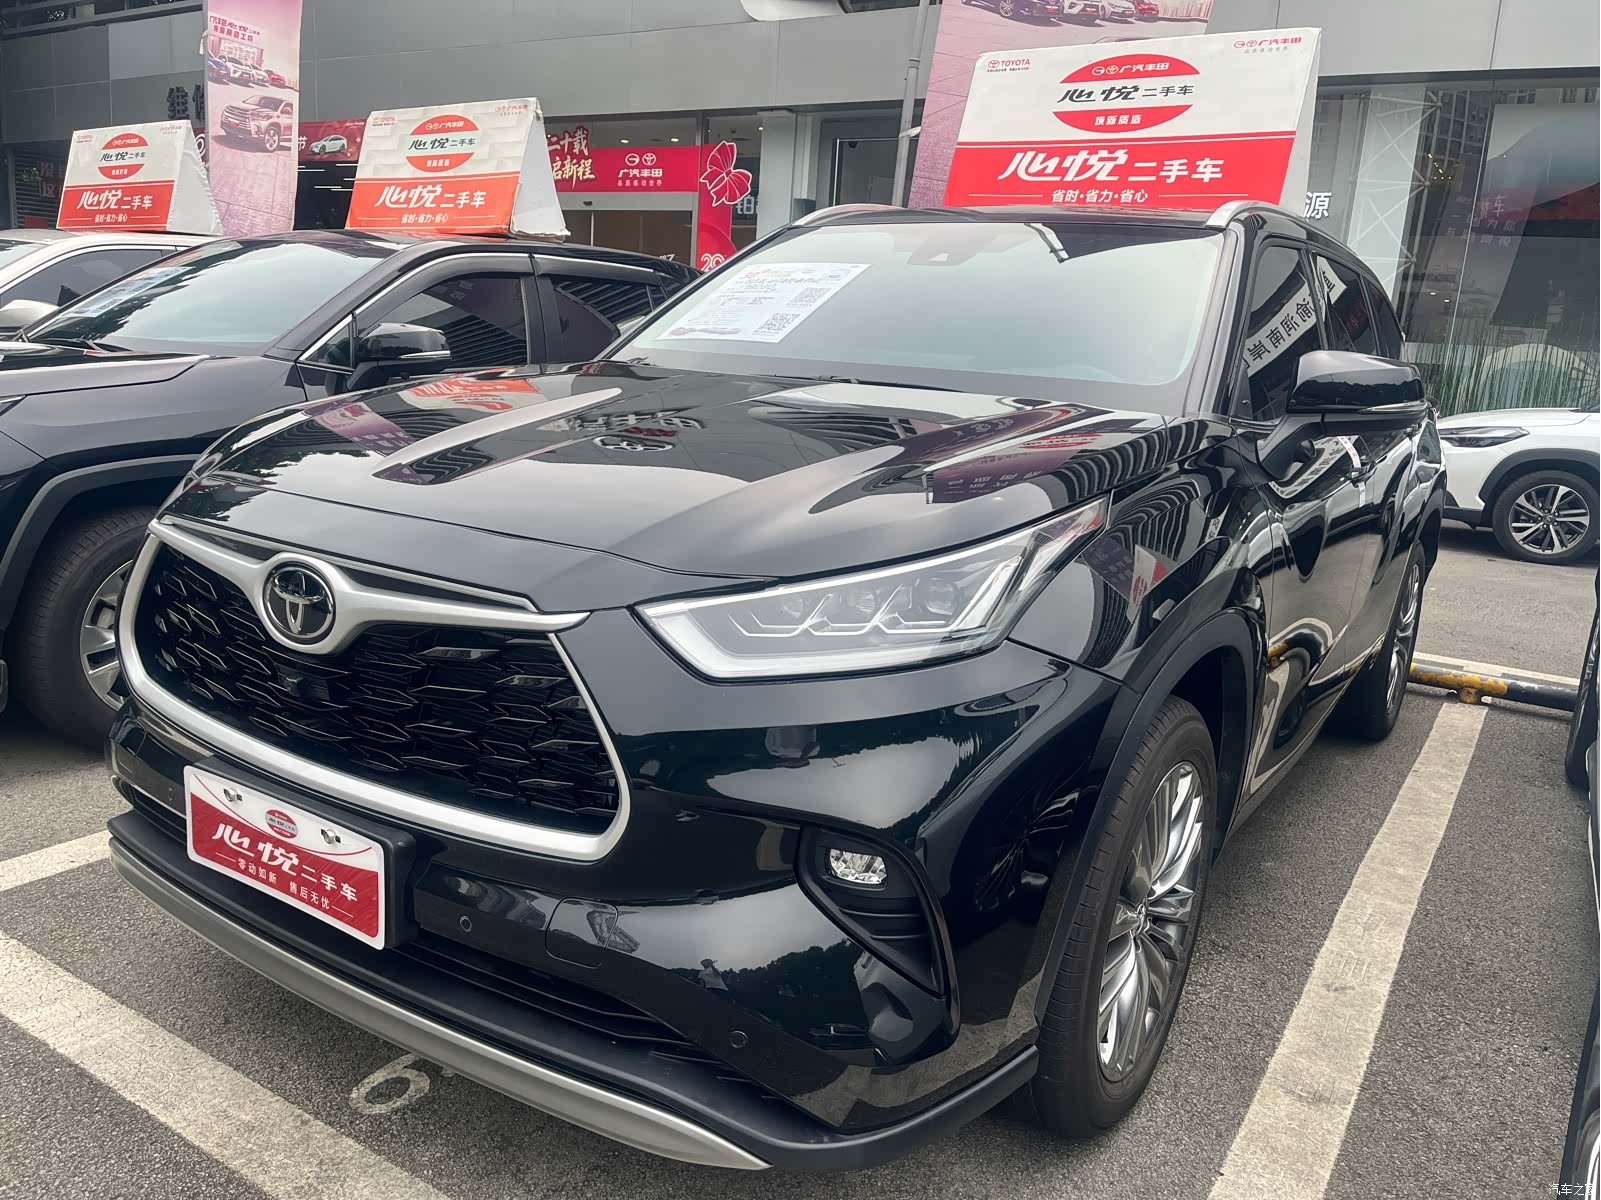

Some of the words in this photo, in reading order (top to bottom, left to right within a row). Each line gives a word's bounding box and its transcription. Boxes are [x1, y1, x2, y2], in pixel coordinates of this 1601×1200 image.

[1258, 37, 1302, 46] 广汽丰田
[1000, 58, 1030, 67] TOYOTA
[1119, 62, 1170, 74] 广汽丰田
[1057, 84, 1194, 103] 心悦二手车
[408, 137, 476, 151] 心悦二手车
[618, 168, 663, 178] 广汽丰田
[997, 148, 1226, 183] 心悦二手车
[77, 189, 153, 210] 心悦二手车
[375, 185, 487, 209] 心悦二手车
[736, 195, 758, 215] 铂
[1304, 192, 1332, 219] 源
[212, 822, 358, 902] 心悦二手车
[289, 880, 331, 910] 售后无忧
[349, 1052, 456, 1114] 6
